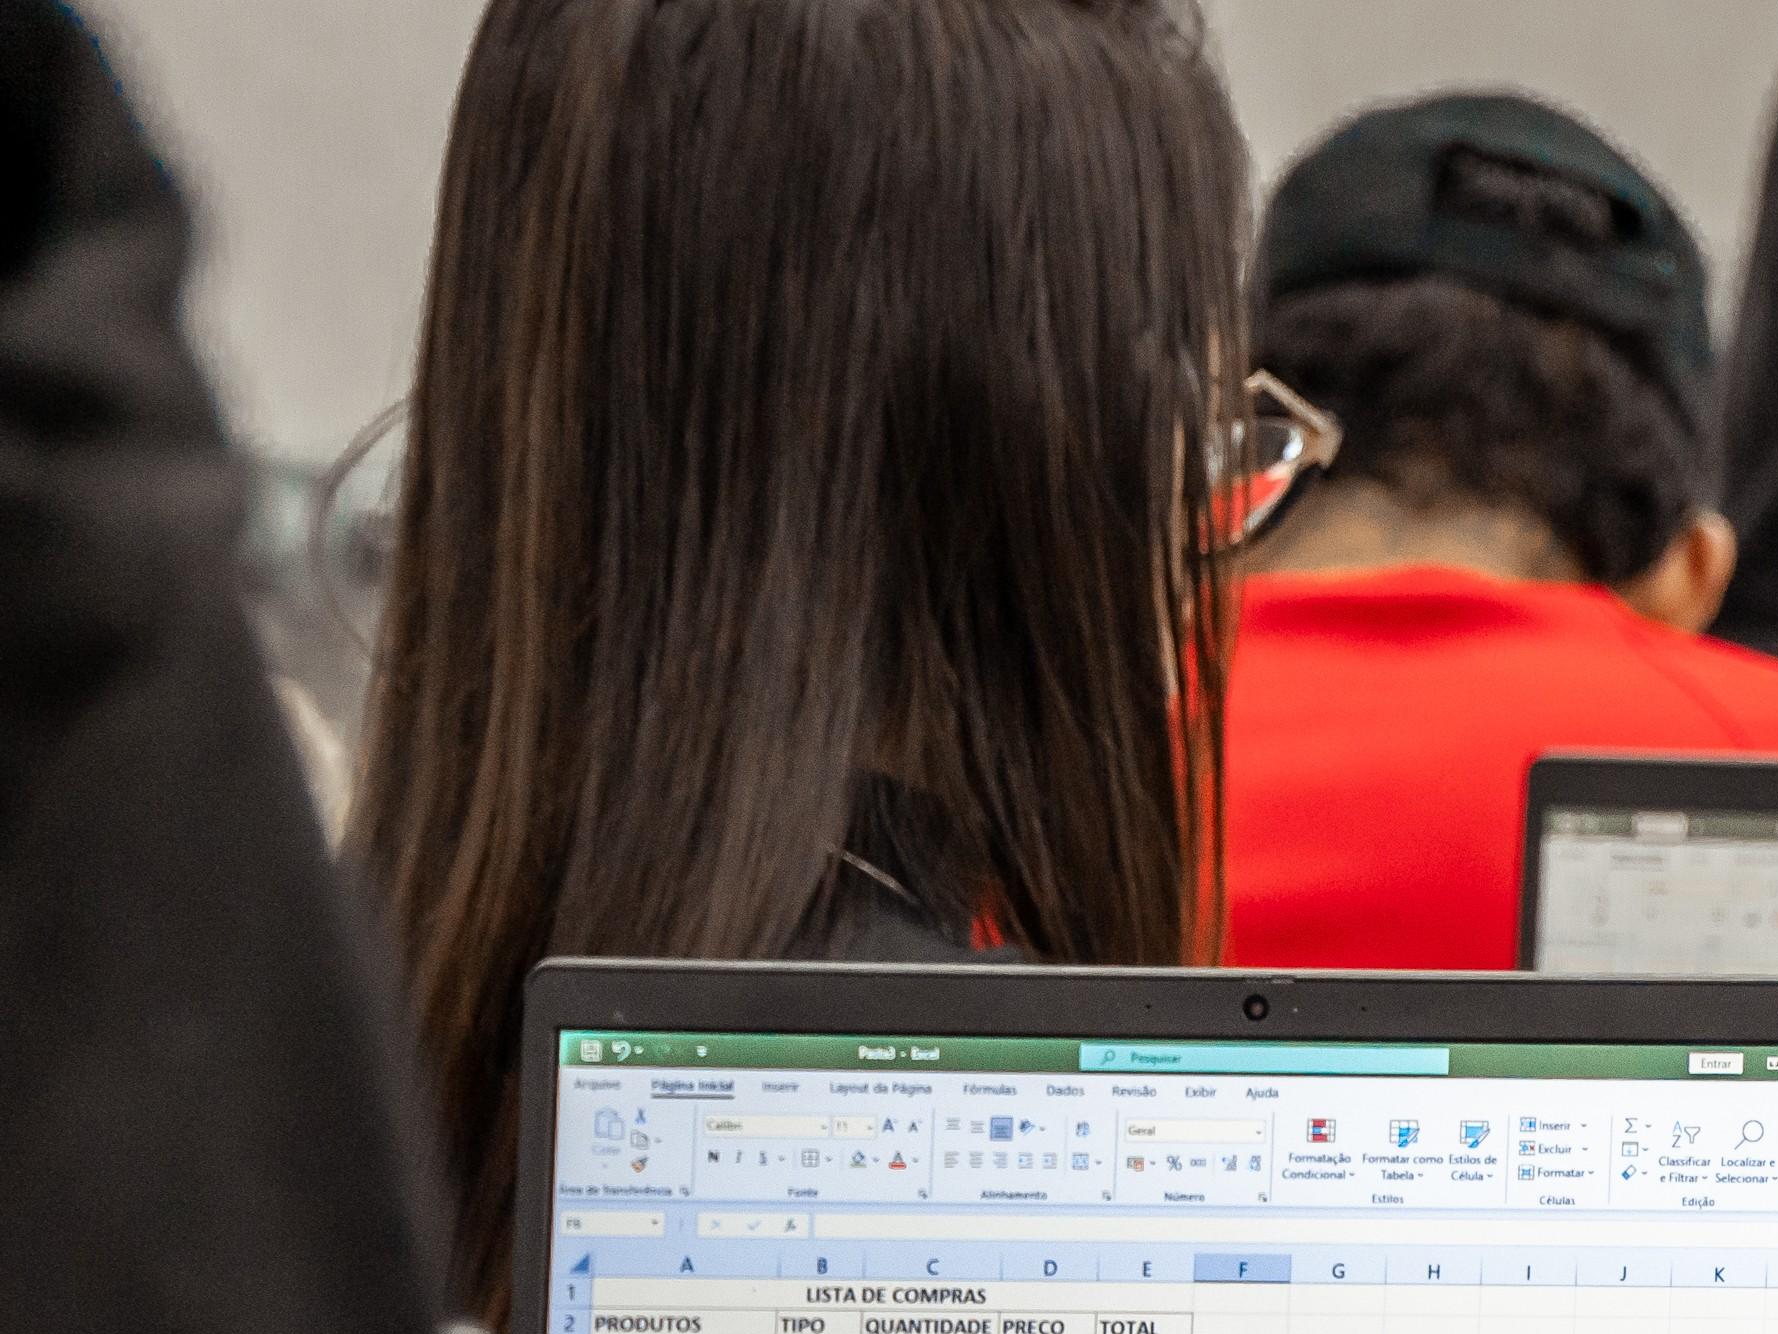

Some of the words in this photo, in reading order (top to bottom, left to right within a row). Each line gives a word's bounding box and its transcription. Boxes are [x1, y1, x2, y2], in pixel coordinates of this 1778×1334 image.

[1131, 1051, 1181, 1065] Pesquisar
[1701, 1058, 1731, 1069] Entrar
[830, 1082, 868, 1096] Layout
[874, 1083, 888, 1094] da
[892, 1082, 932, 1097] Página
[963, 1084, 1017, 1096] Fórmulas
[1047, 1085, 1085, 1096] Dados
[1112, 1086, 1157, 1097] Revisão
[1185, 1087, 1217, 1098] Exibir
[1246, 1087, 1279, 1100] Ajuda
[1128, 1126, 1156, 1136] Geral
[1539, 1121, 1571, 1131] Inserir
[1538, 1144, 1571, 1155] Excluir
[1288, 1153, 1351, 1166] Formatação
[1362, 1153, 1409, 1165] Formatar
[1413, 1155, 1444, 1165] como
[1449, 1154, 1481, 1165] Estilos
[1484, 1154, 1497, 1165] de
[1658, 1156, 1711, 1167] Classificar
[1721, 1157, 1767, 1168] Localizar
[1769, 1159, 1776, 1168] e
[1282, 1168, 1346, 1180] Condicional
[1381, 1170, 1414, 1181] Tabela
[1451, 1170, 1484, 1181] Célula
[1537, 1168, 1585, 1178] Formatar
[1660, 1174, 1666, 1183] e
[1669, 1173, 1699, 1183] Filtrar
[1715, 1173, 1769, 1184] Selecionar
[980, 1190, 1048, 1201] Alinhamento
[1164, 1191, 1205, 1202] Número
[1372, 1194, 1404, 1204] Estilos
[1539, 1195, 1575, 1206] Células
[1682, 1197, 1715, 1209] Edição
[680, 1256, 694, 1273] A
[817, 1257, 828, 1274] B
[926, 1258, 940, 1276] C
[1044, 1260, 1058, 1277] D
[1143, 1261, 1152, 1278] E
[1239, 1261, 1249, 1278] F
[1332, 1263, 1345, 1279] G
[1428, 1265, 1440, 1281] H
[1620, 1266, 1627, 1282] J
[1715, 1267, 1725, 1283] K
[568, 1286, 576, 1301] 1
[806, 1287, 856, 1303] LISTA
[861, 1288, 887, 1304] DE
[892, 1288, 986, 1305] COMPRAS
[564, 1315, 576, 1332] 2
[594, 1316, 702, 1333] PRODUTOS
[781, 1317, 825, 1333] TIPO
